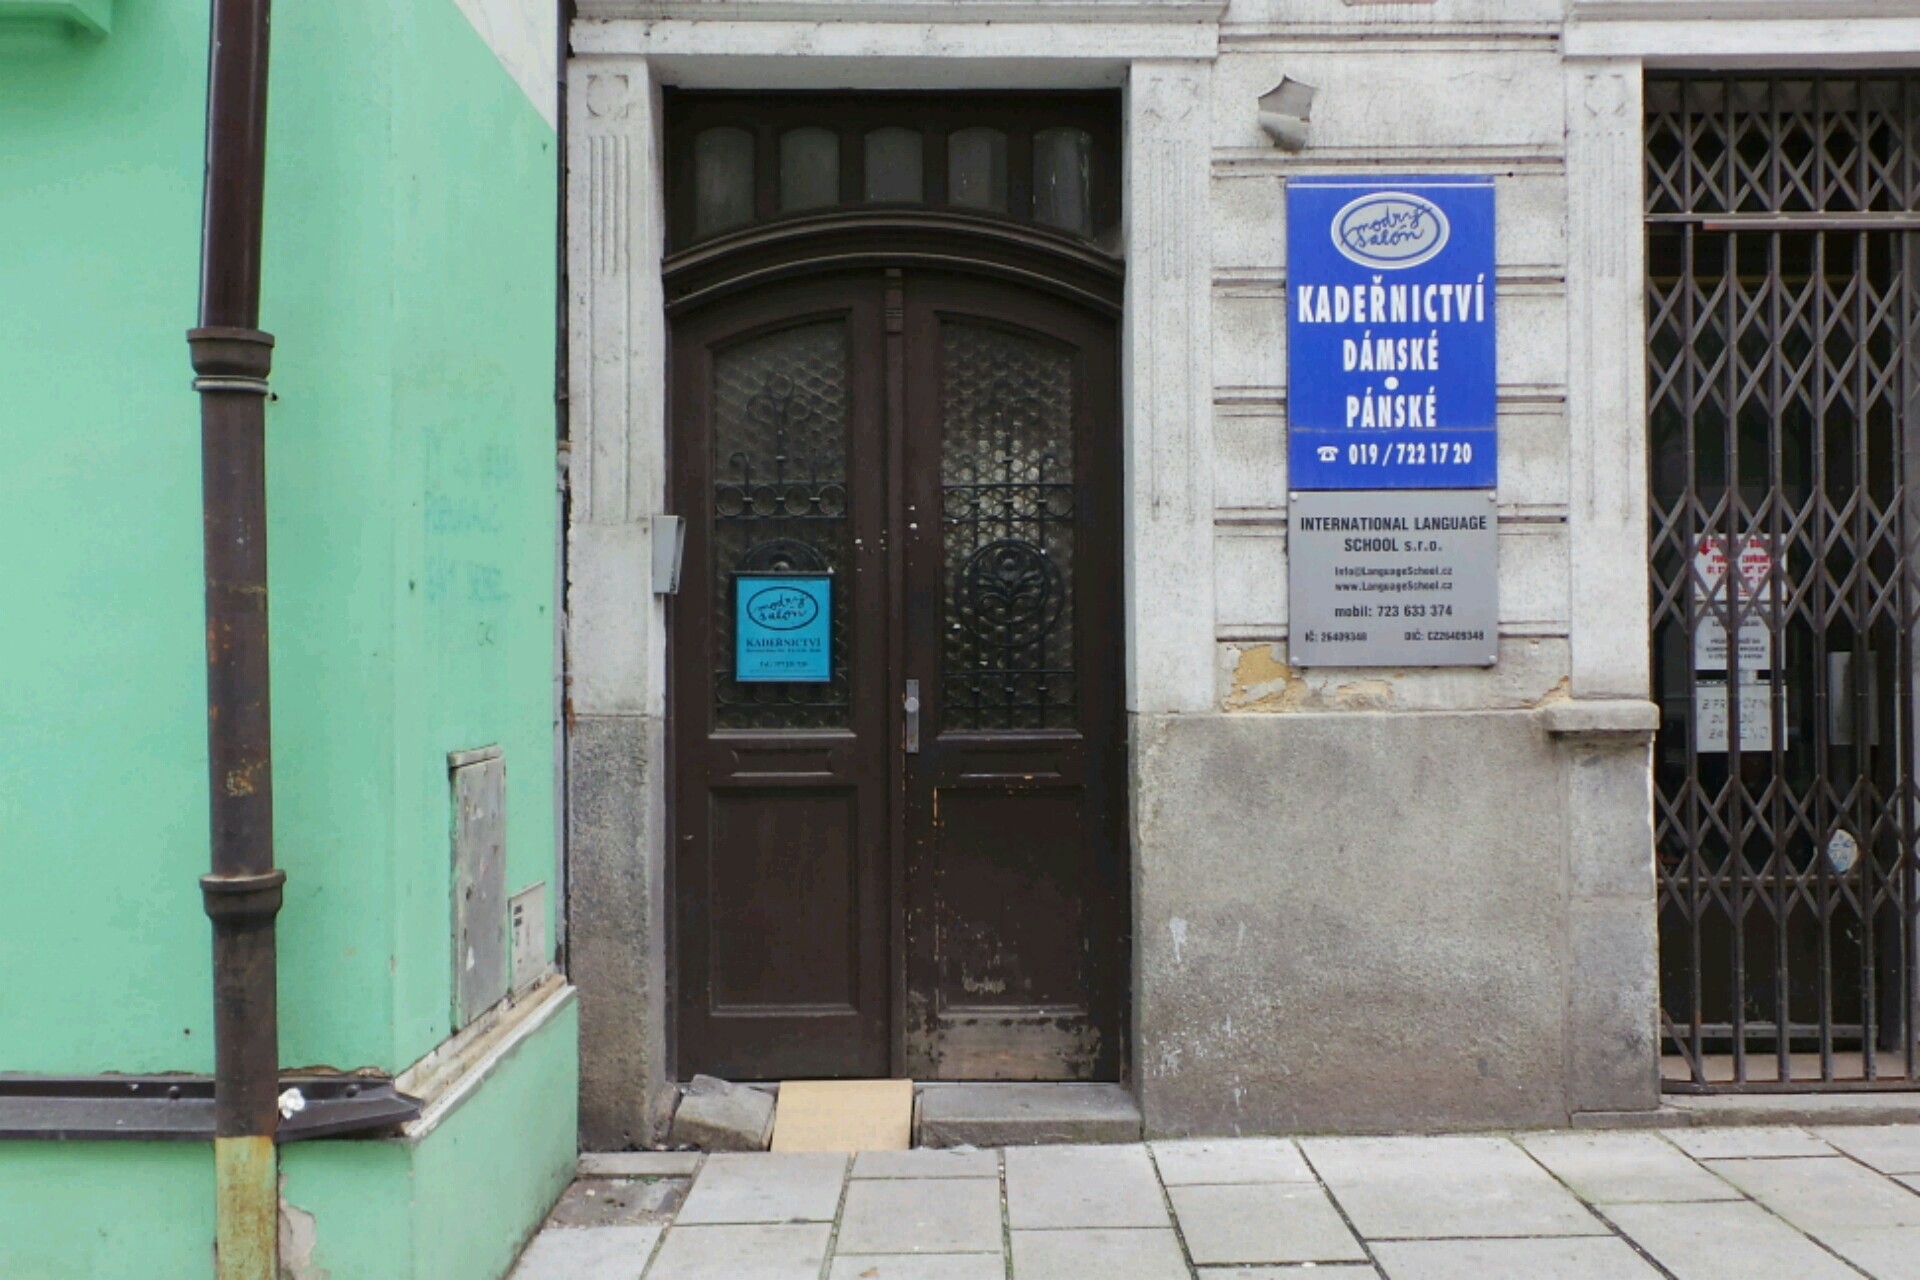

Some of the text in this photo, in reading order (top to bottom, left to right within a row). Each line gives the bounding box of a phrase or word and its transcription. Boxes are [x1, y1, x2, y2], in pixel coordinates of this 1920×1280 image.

[1298, 273, 1485, 323] KADEŘNICTVÍ
[1343, 329, 1439, 372] DÁMSKÉ
[1346, 386, 1437, 428] PÁNSKÉ
[1348, 444, 1378, 465] 019
[1301, 516, 1487, 531] INTERNATIONAL LANGUAGE
[1344, 538, 1443, 552] SCHOOL s.r.o.
[1335, 581, 1453, 592] www.LanguageSchool.cz
[1335, 604, 1453, 617] mobil: 723 633 374
